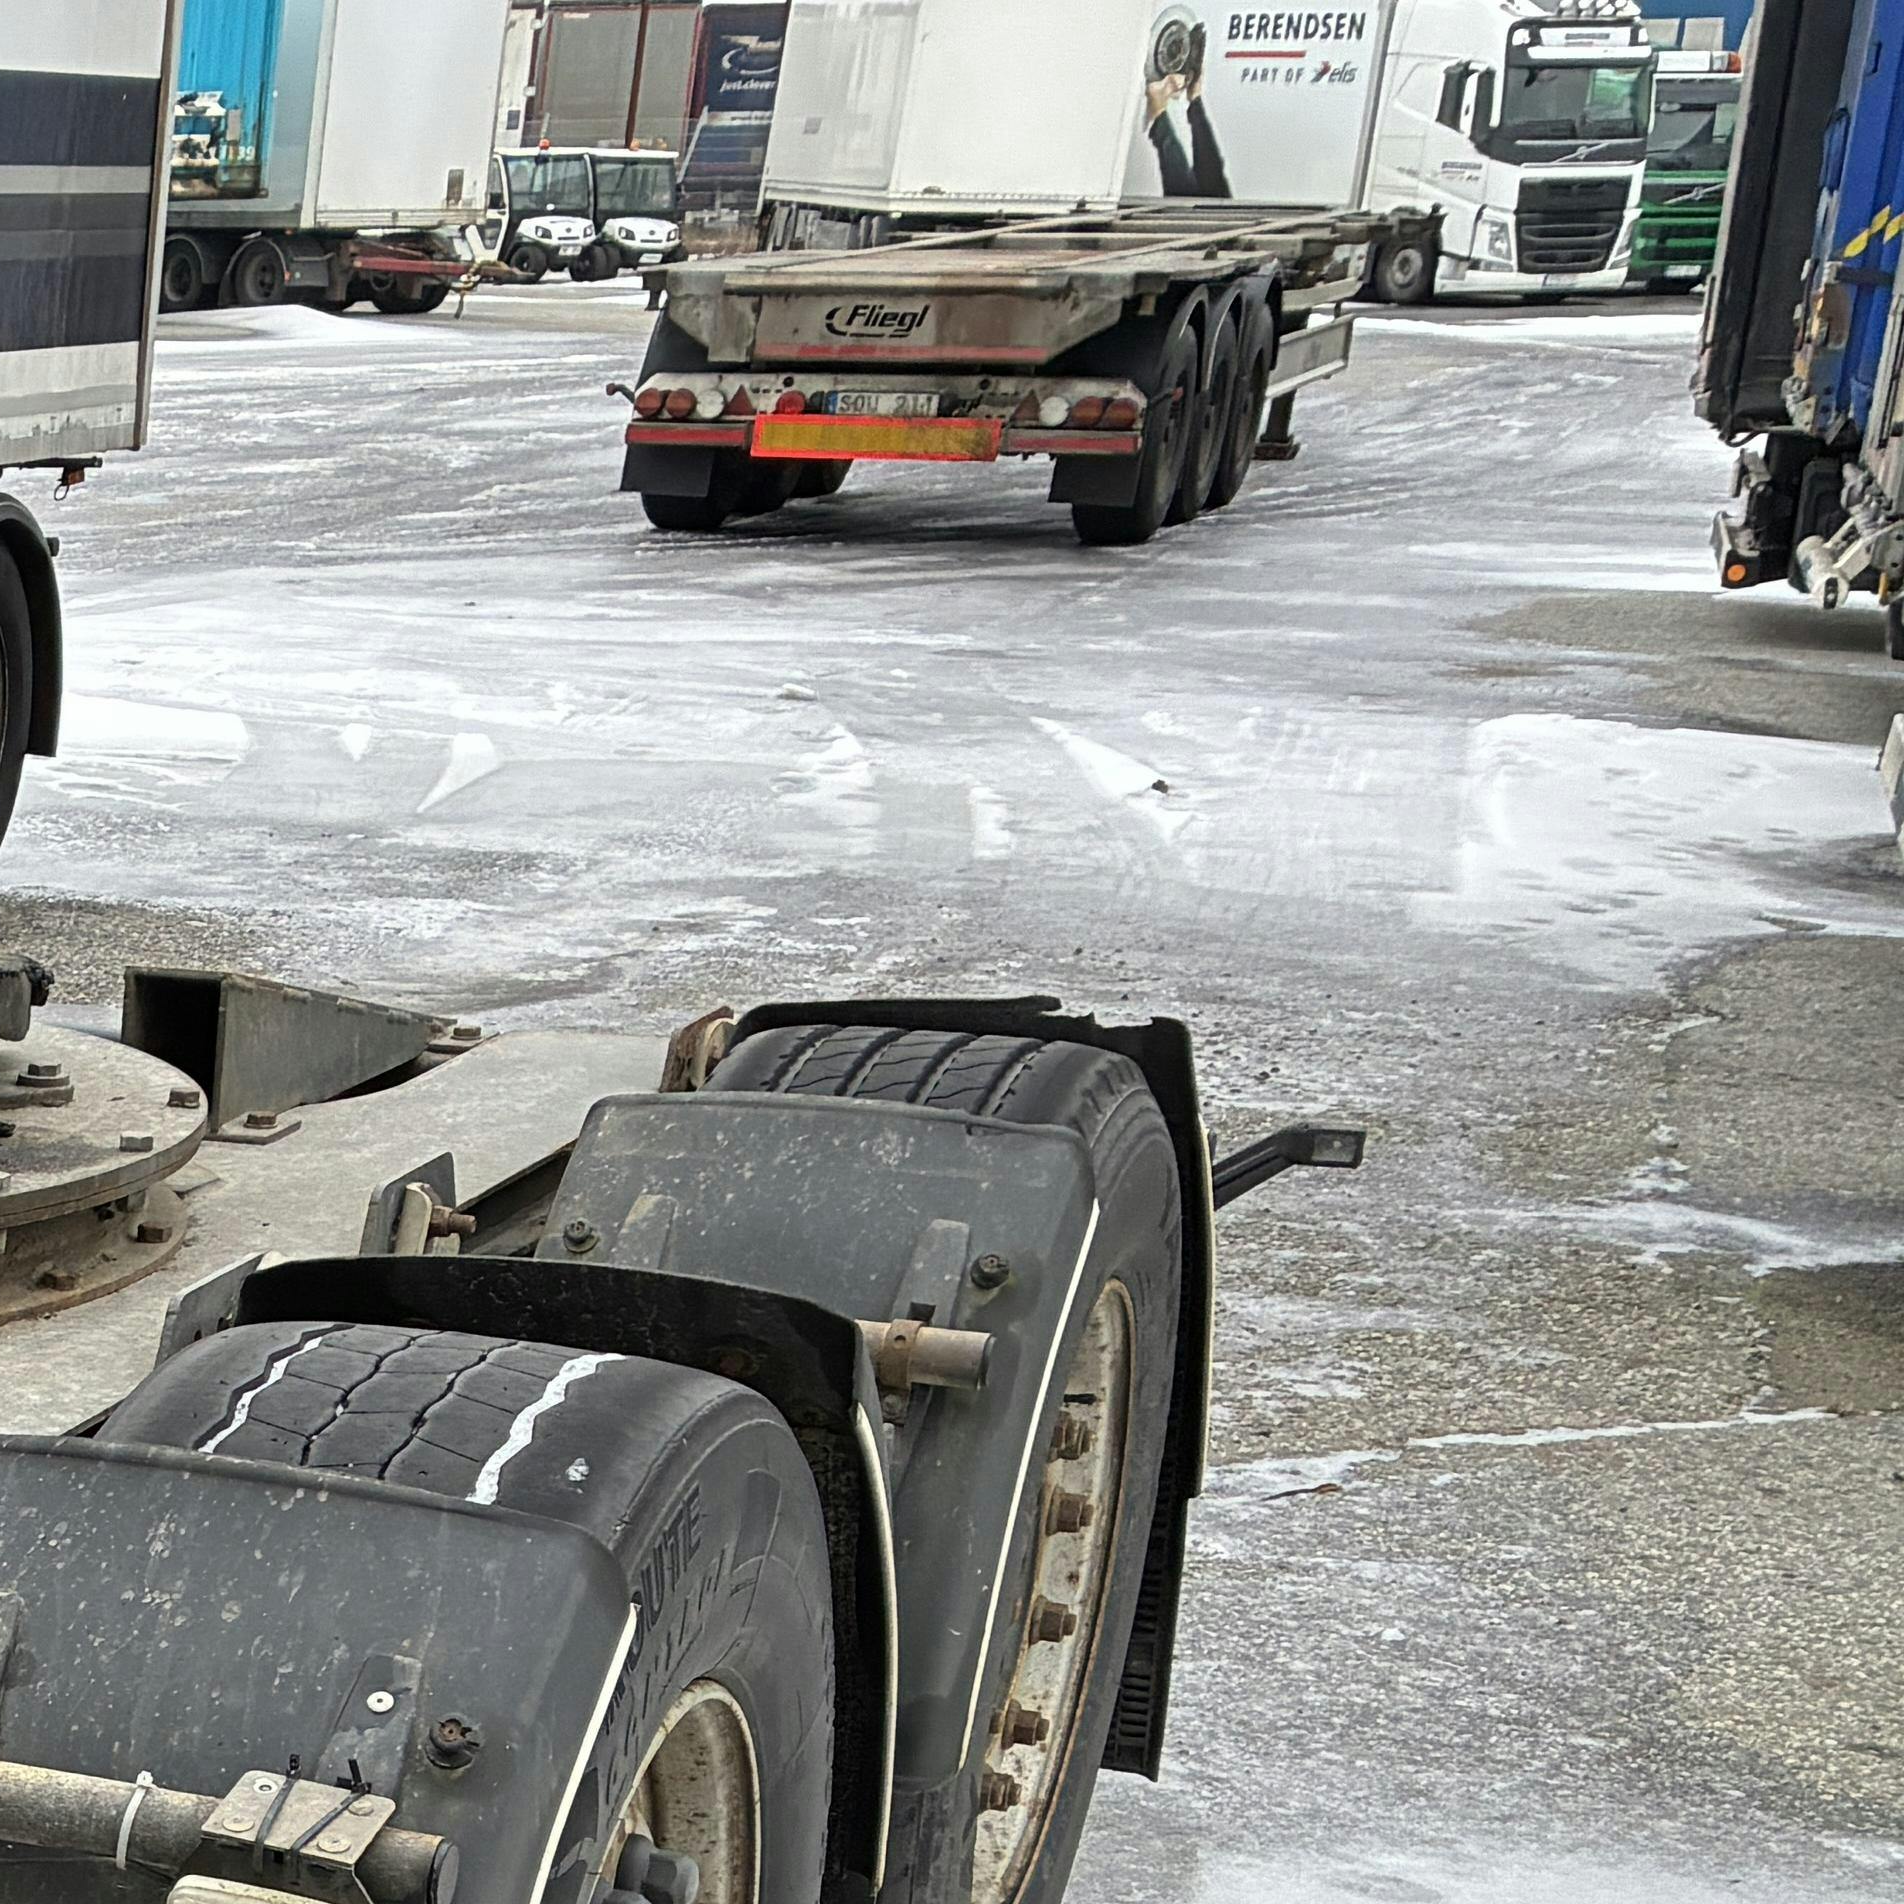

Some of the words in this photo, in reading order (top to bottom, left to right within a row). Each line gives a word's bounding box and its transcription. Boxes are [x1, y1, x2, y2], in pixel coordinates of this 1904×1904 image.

[1227, 12, 1367, 40] BERENDSEN
[1240, 67, 1279, 83] PART
[1284, 67, 1305, 83] OF
[845, 304, 931, 333] Fliegl
